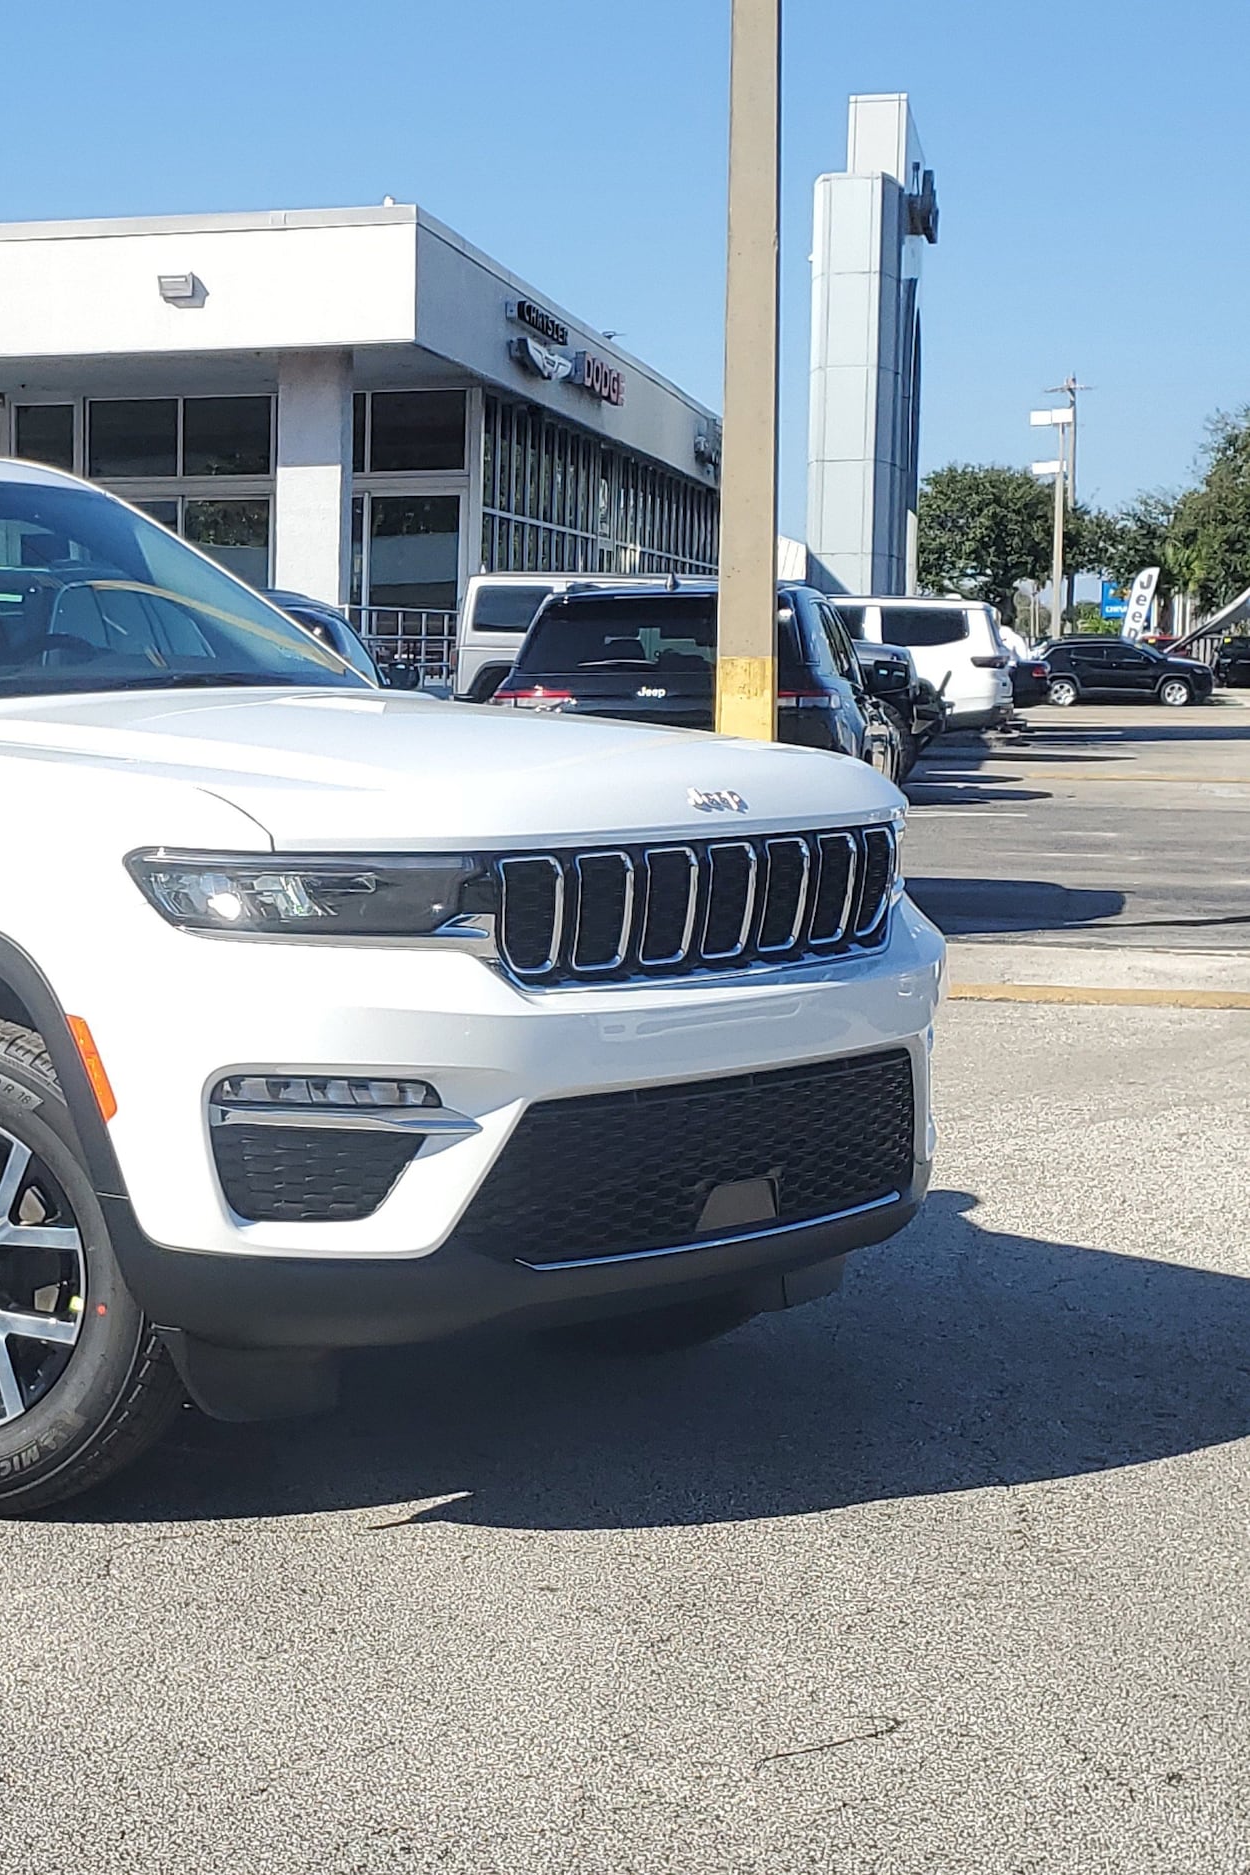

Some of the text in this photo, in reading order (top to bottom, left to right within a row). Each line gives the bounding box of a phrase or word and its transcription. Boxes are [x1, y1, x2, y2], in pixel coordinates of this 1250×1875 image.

[584, 351, 626, 406] DODGE
[637, 686, 666, 698] Jeep
[687, 787, 748, 814] Jeep
